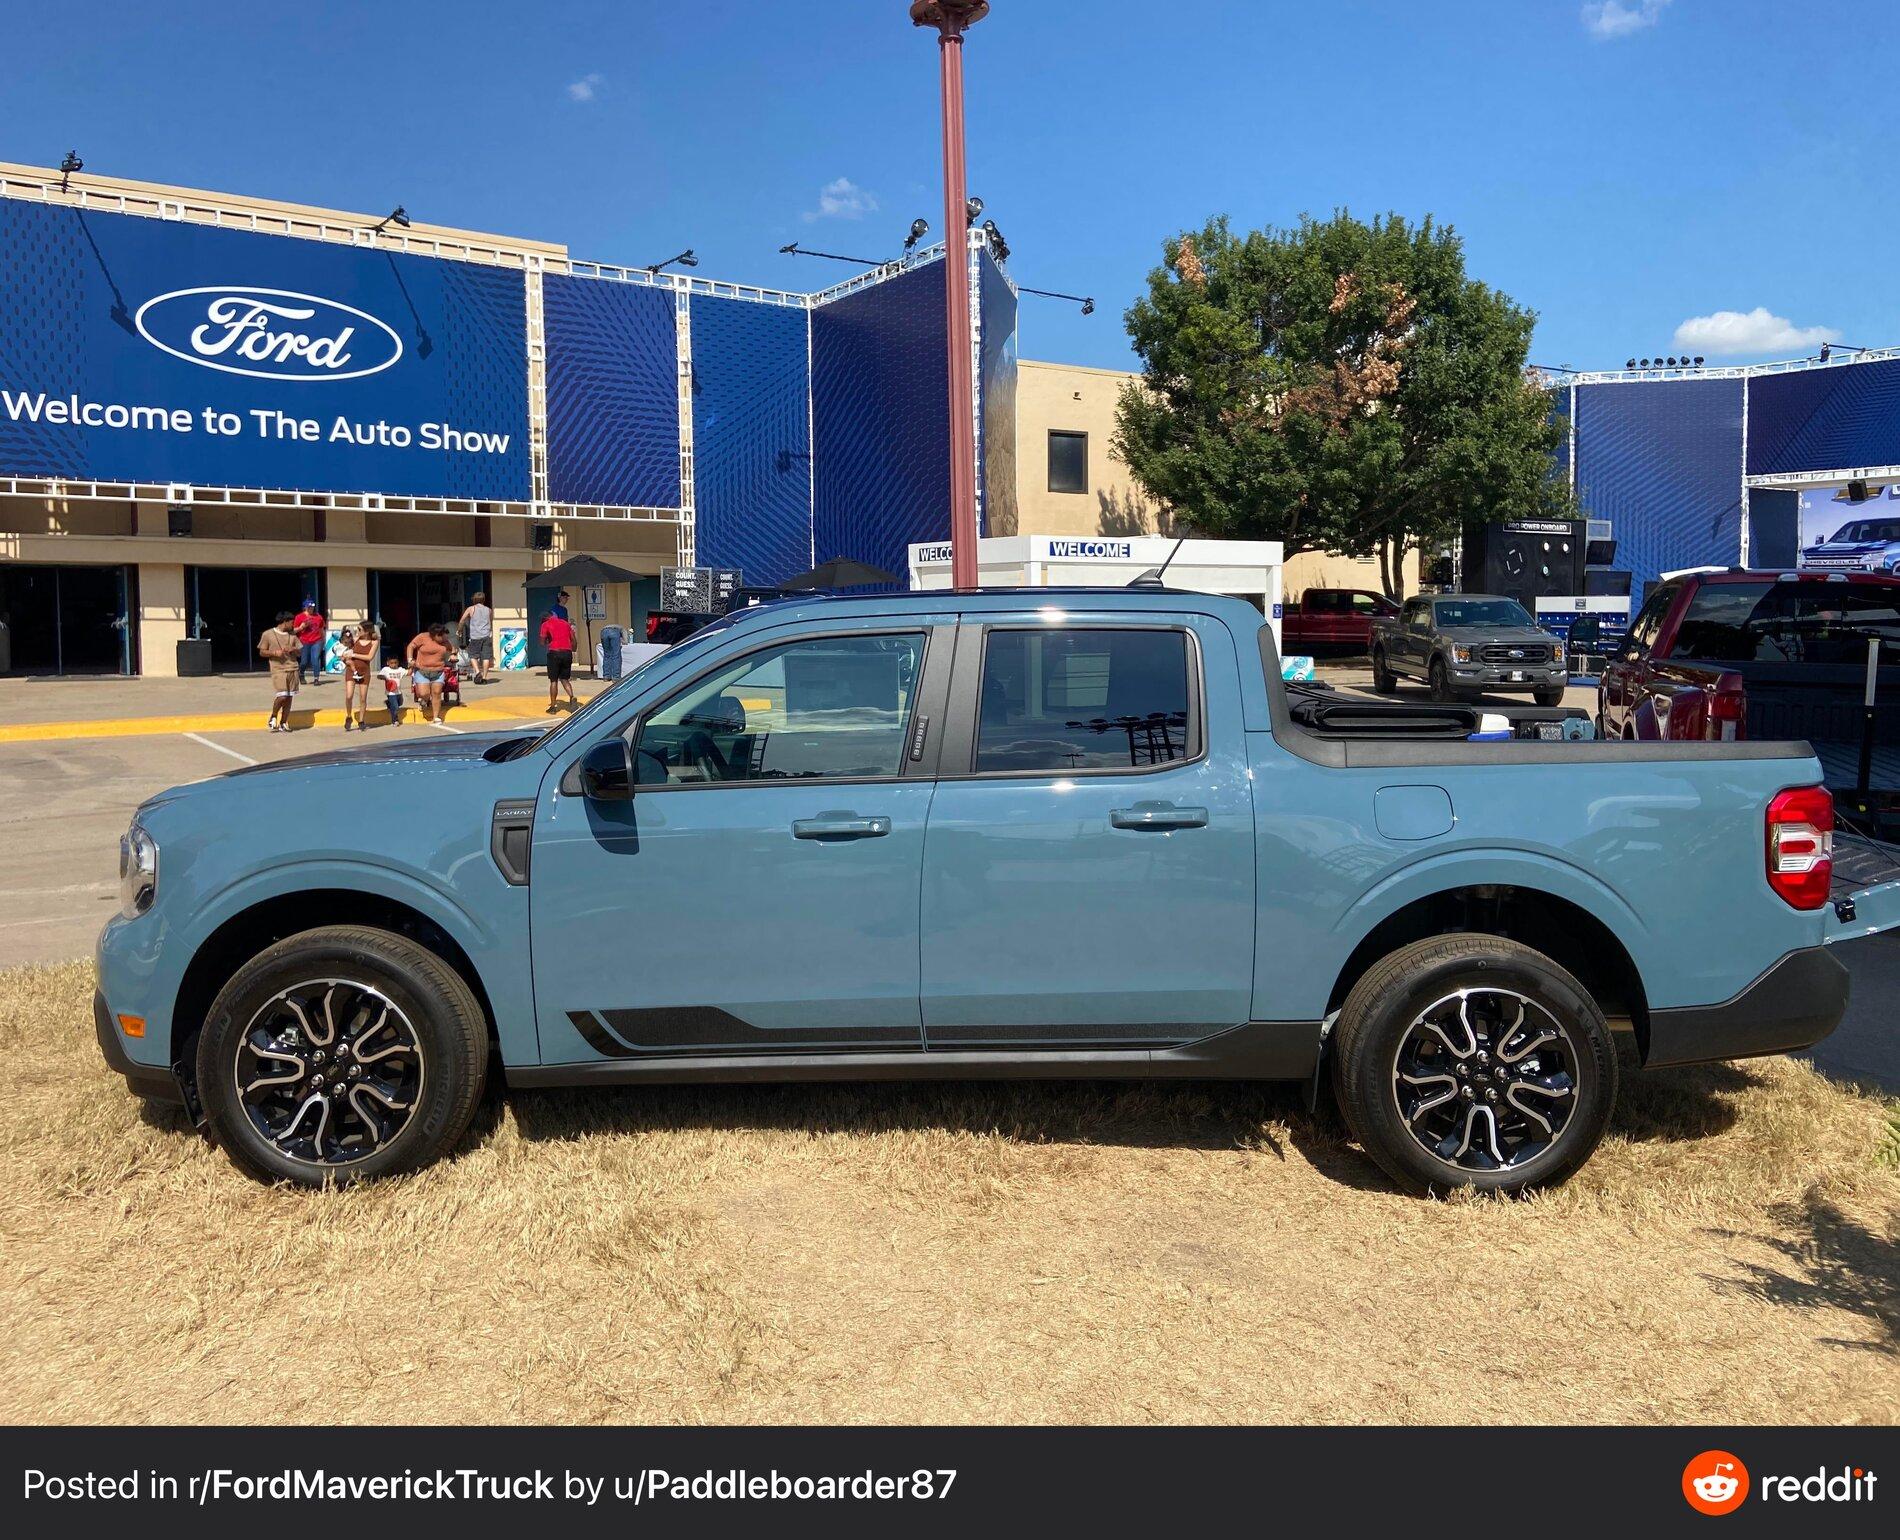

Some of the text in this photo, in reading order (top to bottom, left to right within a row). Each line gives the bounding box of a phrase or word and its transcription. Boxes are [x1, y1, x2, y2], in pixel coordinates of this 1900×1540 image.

[191, 297, 355, 369] Ford
[1, 390, 510, 454] Welcome to The Auto Show
[919, 547, 953, 562] WELCO
[1051, 541, 1130, 558] WELCOME
[675, 572, 697, 580] COUNT.
